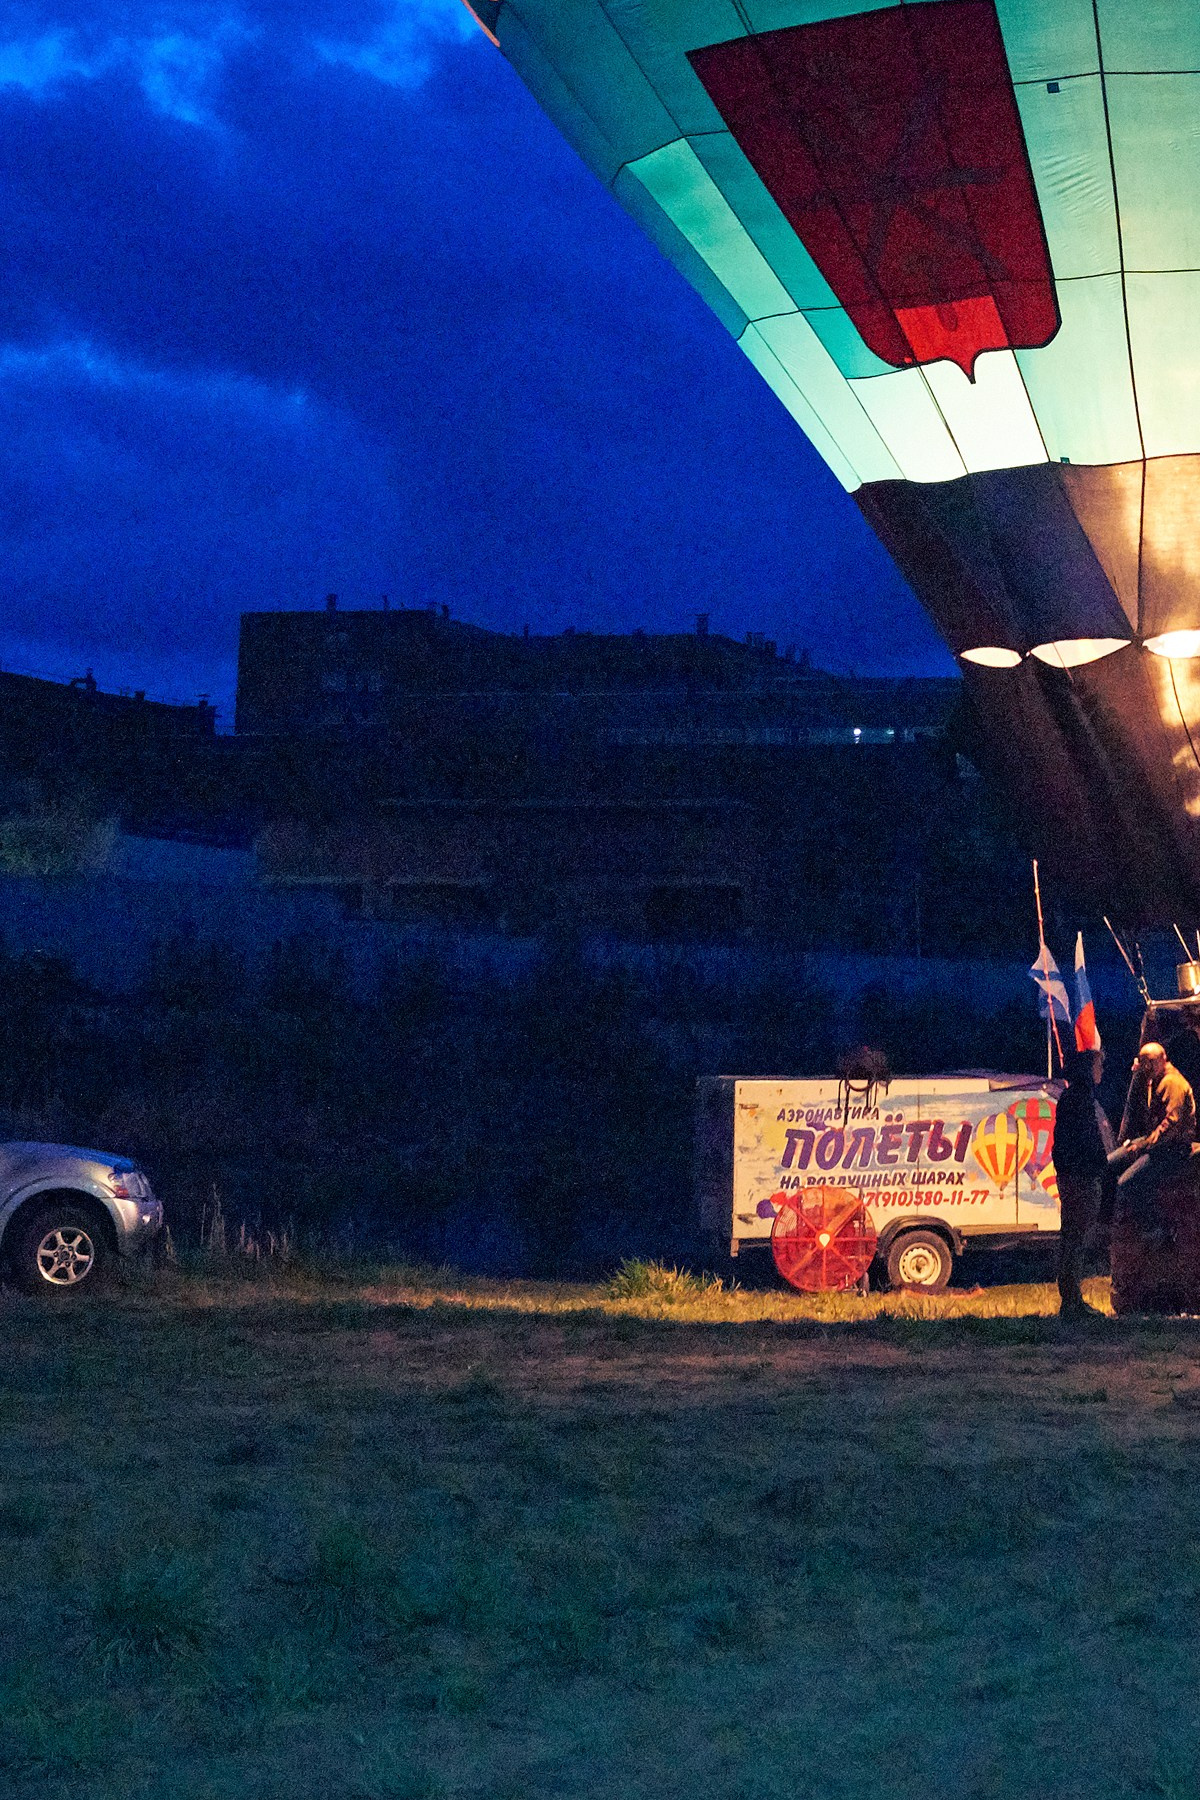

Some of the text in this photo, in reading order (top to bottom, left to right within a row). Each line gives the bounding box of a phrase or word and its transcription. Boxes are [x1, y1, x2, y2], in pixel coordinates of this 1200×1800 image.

[780, 1113, 973, 1171] ПОЛЁТЫ
[779, 1175, 801, 1190] НА
[911, 1170, 965, 1186] ШАРАХ
